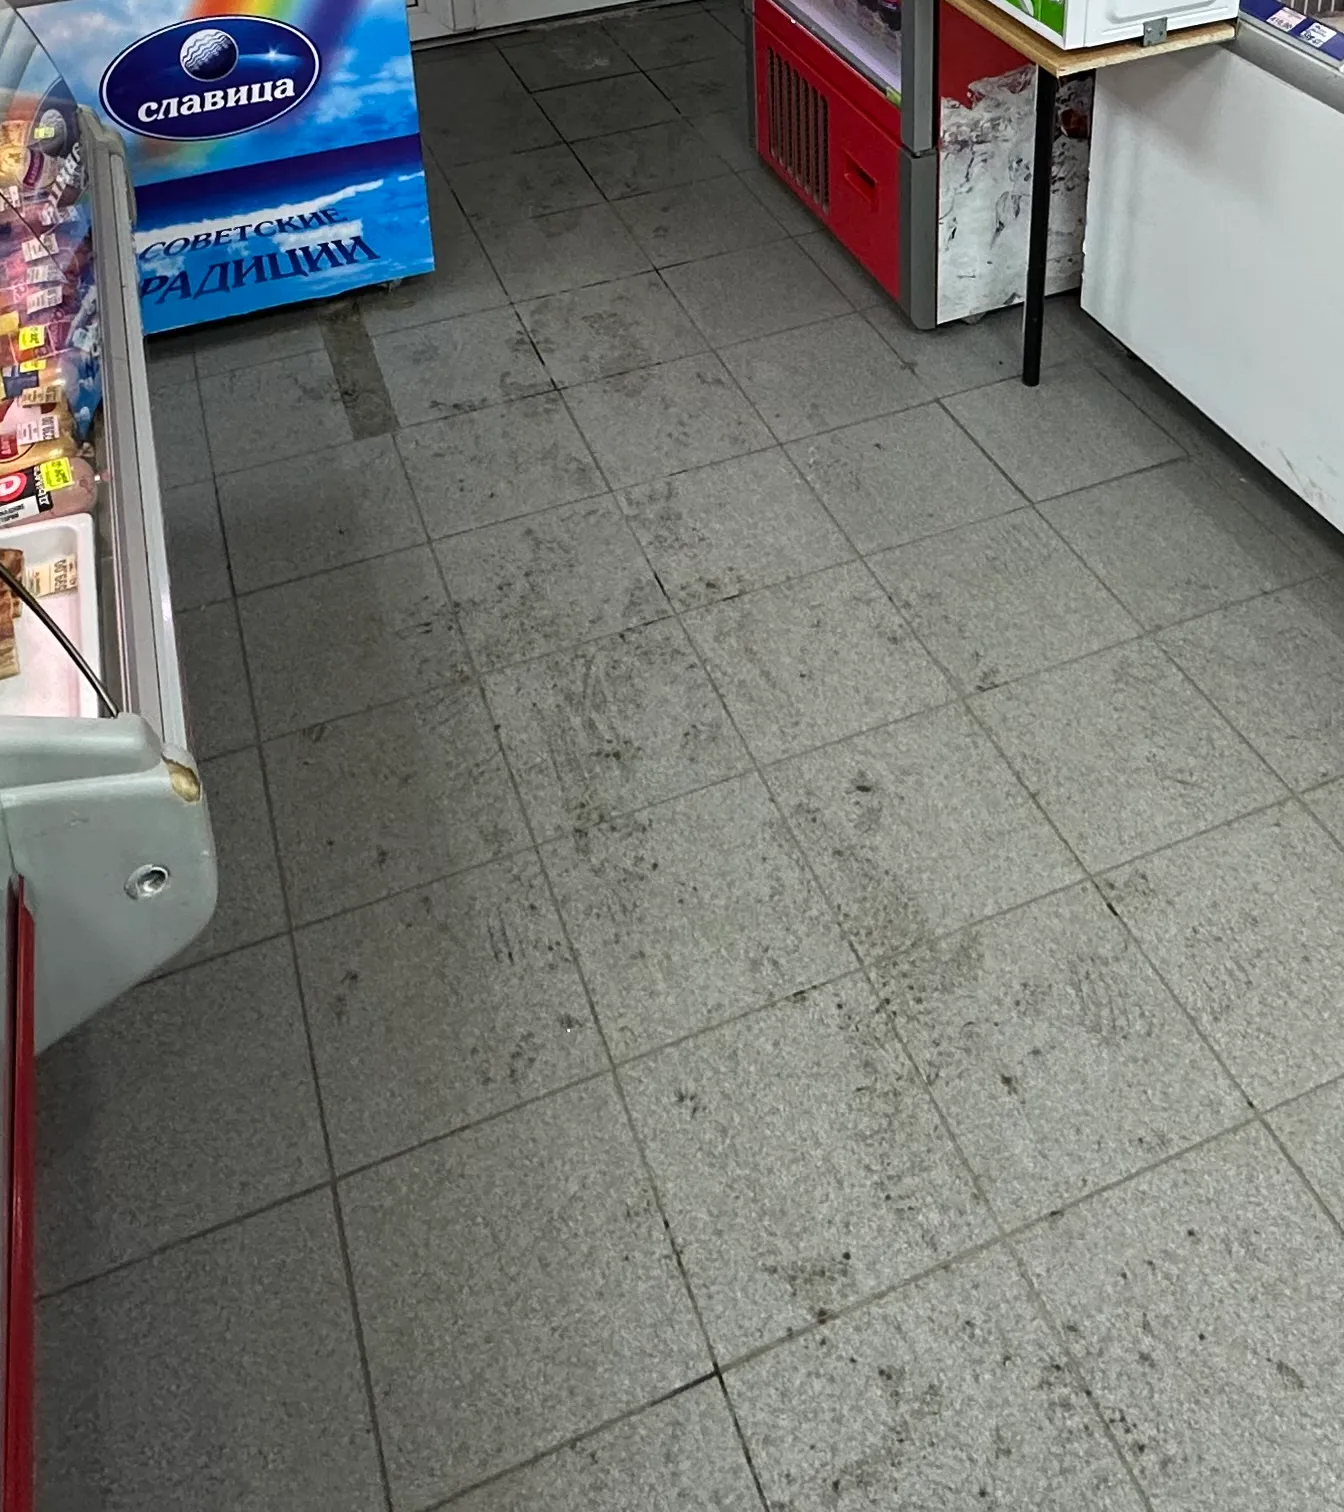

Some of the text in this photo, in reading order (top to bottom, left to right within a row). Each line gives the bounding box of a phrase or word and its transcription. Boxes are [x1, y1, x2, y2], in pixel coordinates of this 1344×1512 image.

[136, 74, 297, 124] славица
[138, 207, 346, 262] СОВЕТСКИЕ
[137, 235, 379, 306] РАДИЦИИ
